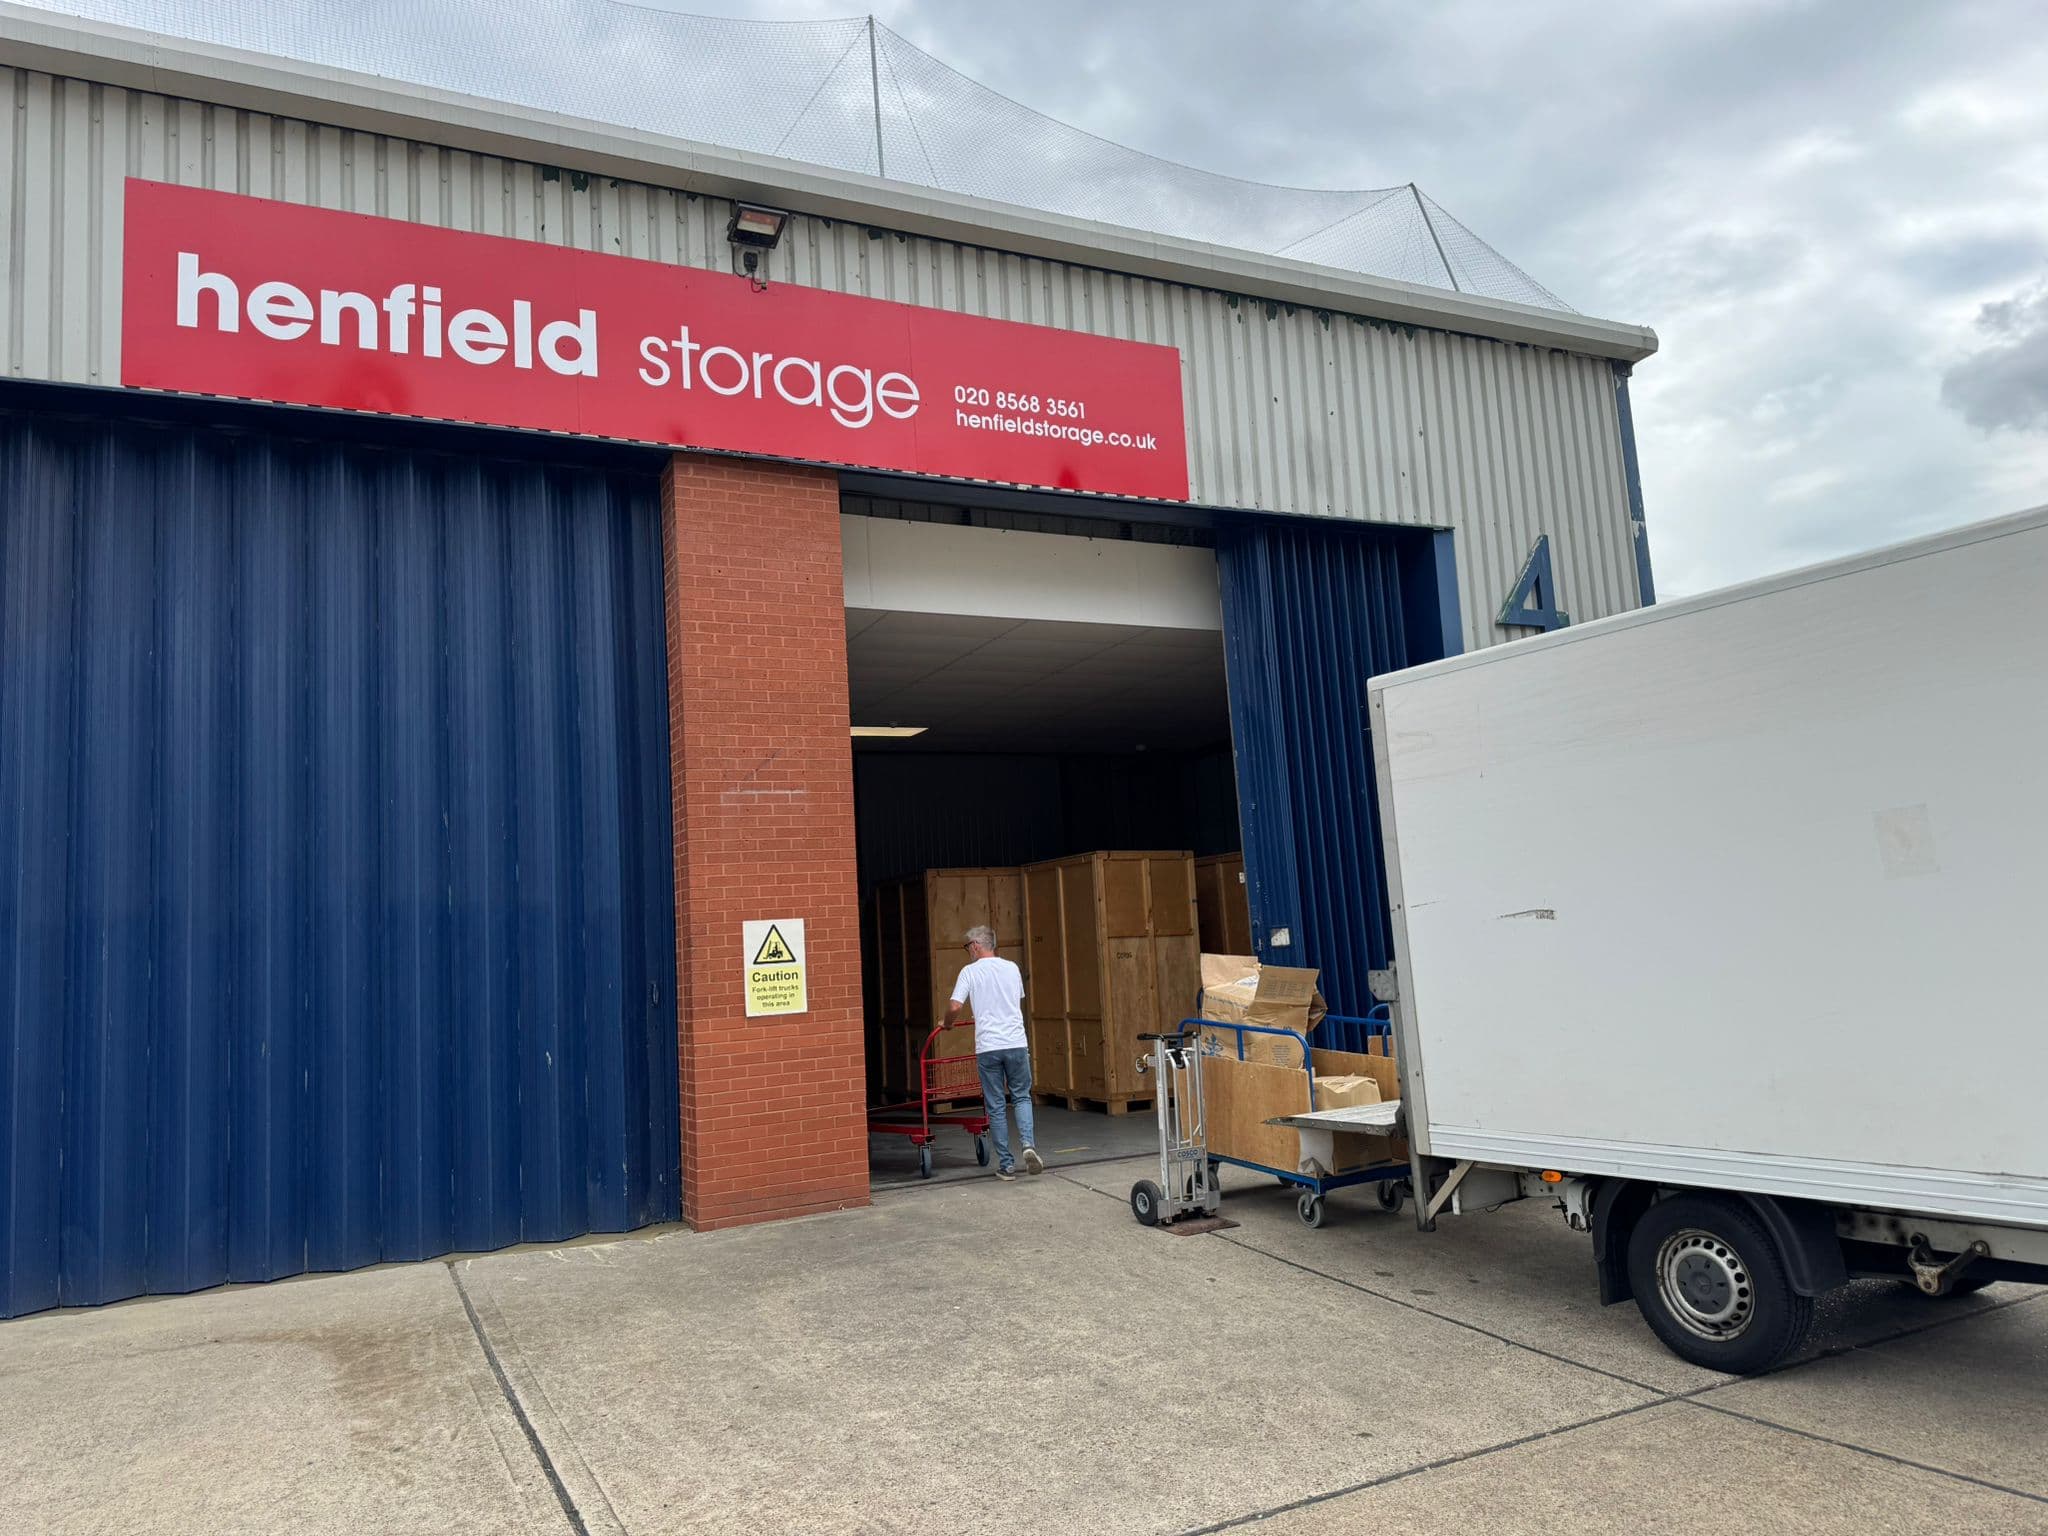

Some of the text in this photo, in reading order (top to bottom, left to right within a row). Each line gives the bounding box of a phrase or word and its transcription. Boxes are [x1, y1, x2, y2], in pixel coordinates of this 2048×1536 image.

[176, 251, 921, 429] henfield storage
[954, 385, 1086, 419] 020 8568 3561
[956, 408, 1158, 451] henfieldstorage.co.uk
[1495, 534, 1571, 632] 4
[752, 970, 799, 983] Caution
